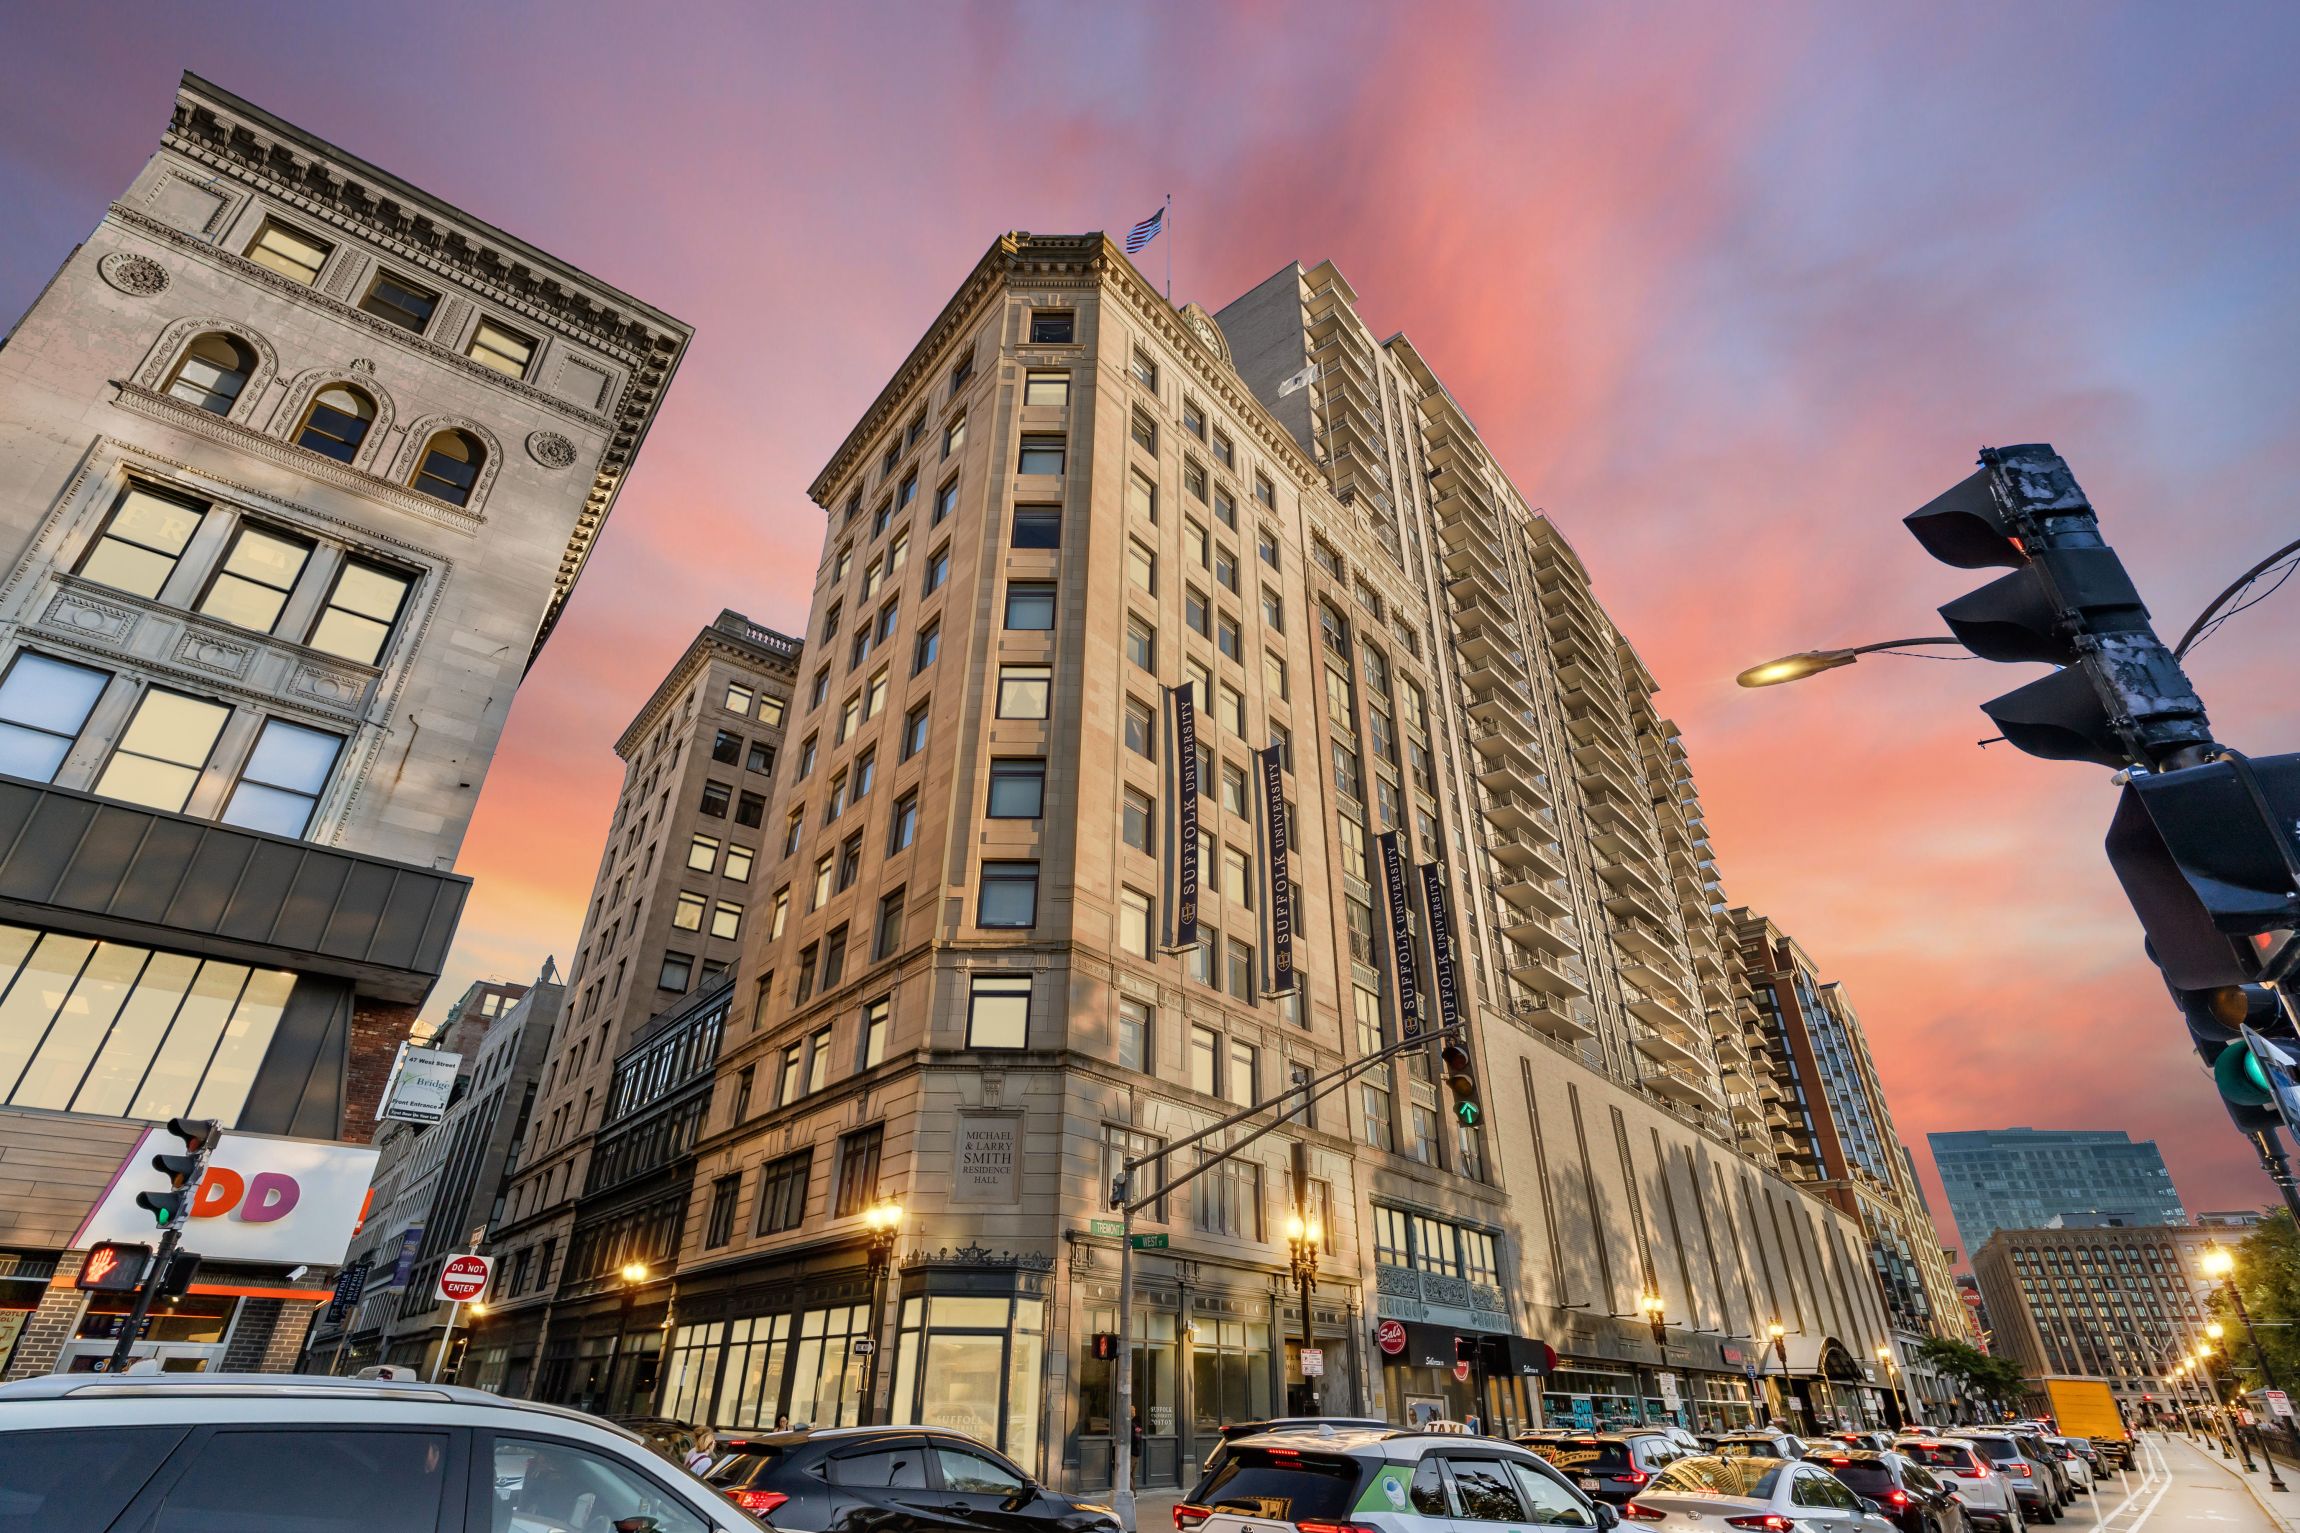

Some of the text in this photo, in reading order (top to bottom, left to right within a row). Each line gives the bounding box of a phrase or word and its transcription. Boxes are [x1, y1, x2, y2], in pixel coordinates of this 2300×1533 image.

[1181, 700, 1196, 895] SUFFOLK UNIVERSITY
[1268, 763, 1289, 944] SUFFOLK UNIVERSITY
[1387, 847, 1415, 1010] SUFFOLK UNIVERSITY
[1428, 876, 1456, 1027] UFFOLK UNIVERSITY
[416, 1077, 450, 1090] Bridge
[409, 1101, 438, 1109] Entrance
[966, 1131, 1013, 1140] MICHAEL
[965, 1142, 1013, 1151] & LARRY
[963, 1153, 1011, 1164] SMITH
[963, 1166, 1011, 1174] RESIDENCE
[974, 1176, 999, 1184] HALL
[190, 1166, 301, 1223] DD
[1096, 1222, 1120, 1237] TREMONT
[1143, 1236, 1158, 1247] WEST
[451, 1263, 485, 1273] DO NOT
[333, 1274, 349, 1306] SUFFOLK
[345, 1267, 361, 1301] SUFFOLK
[448, 1283, 475, 1292] ENTER
[1380, 1325, 1402, 1342] Sal's
[1428, 1423, 1463, 1434] TAXI
